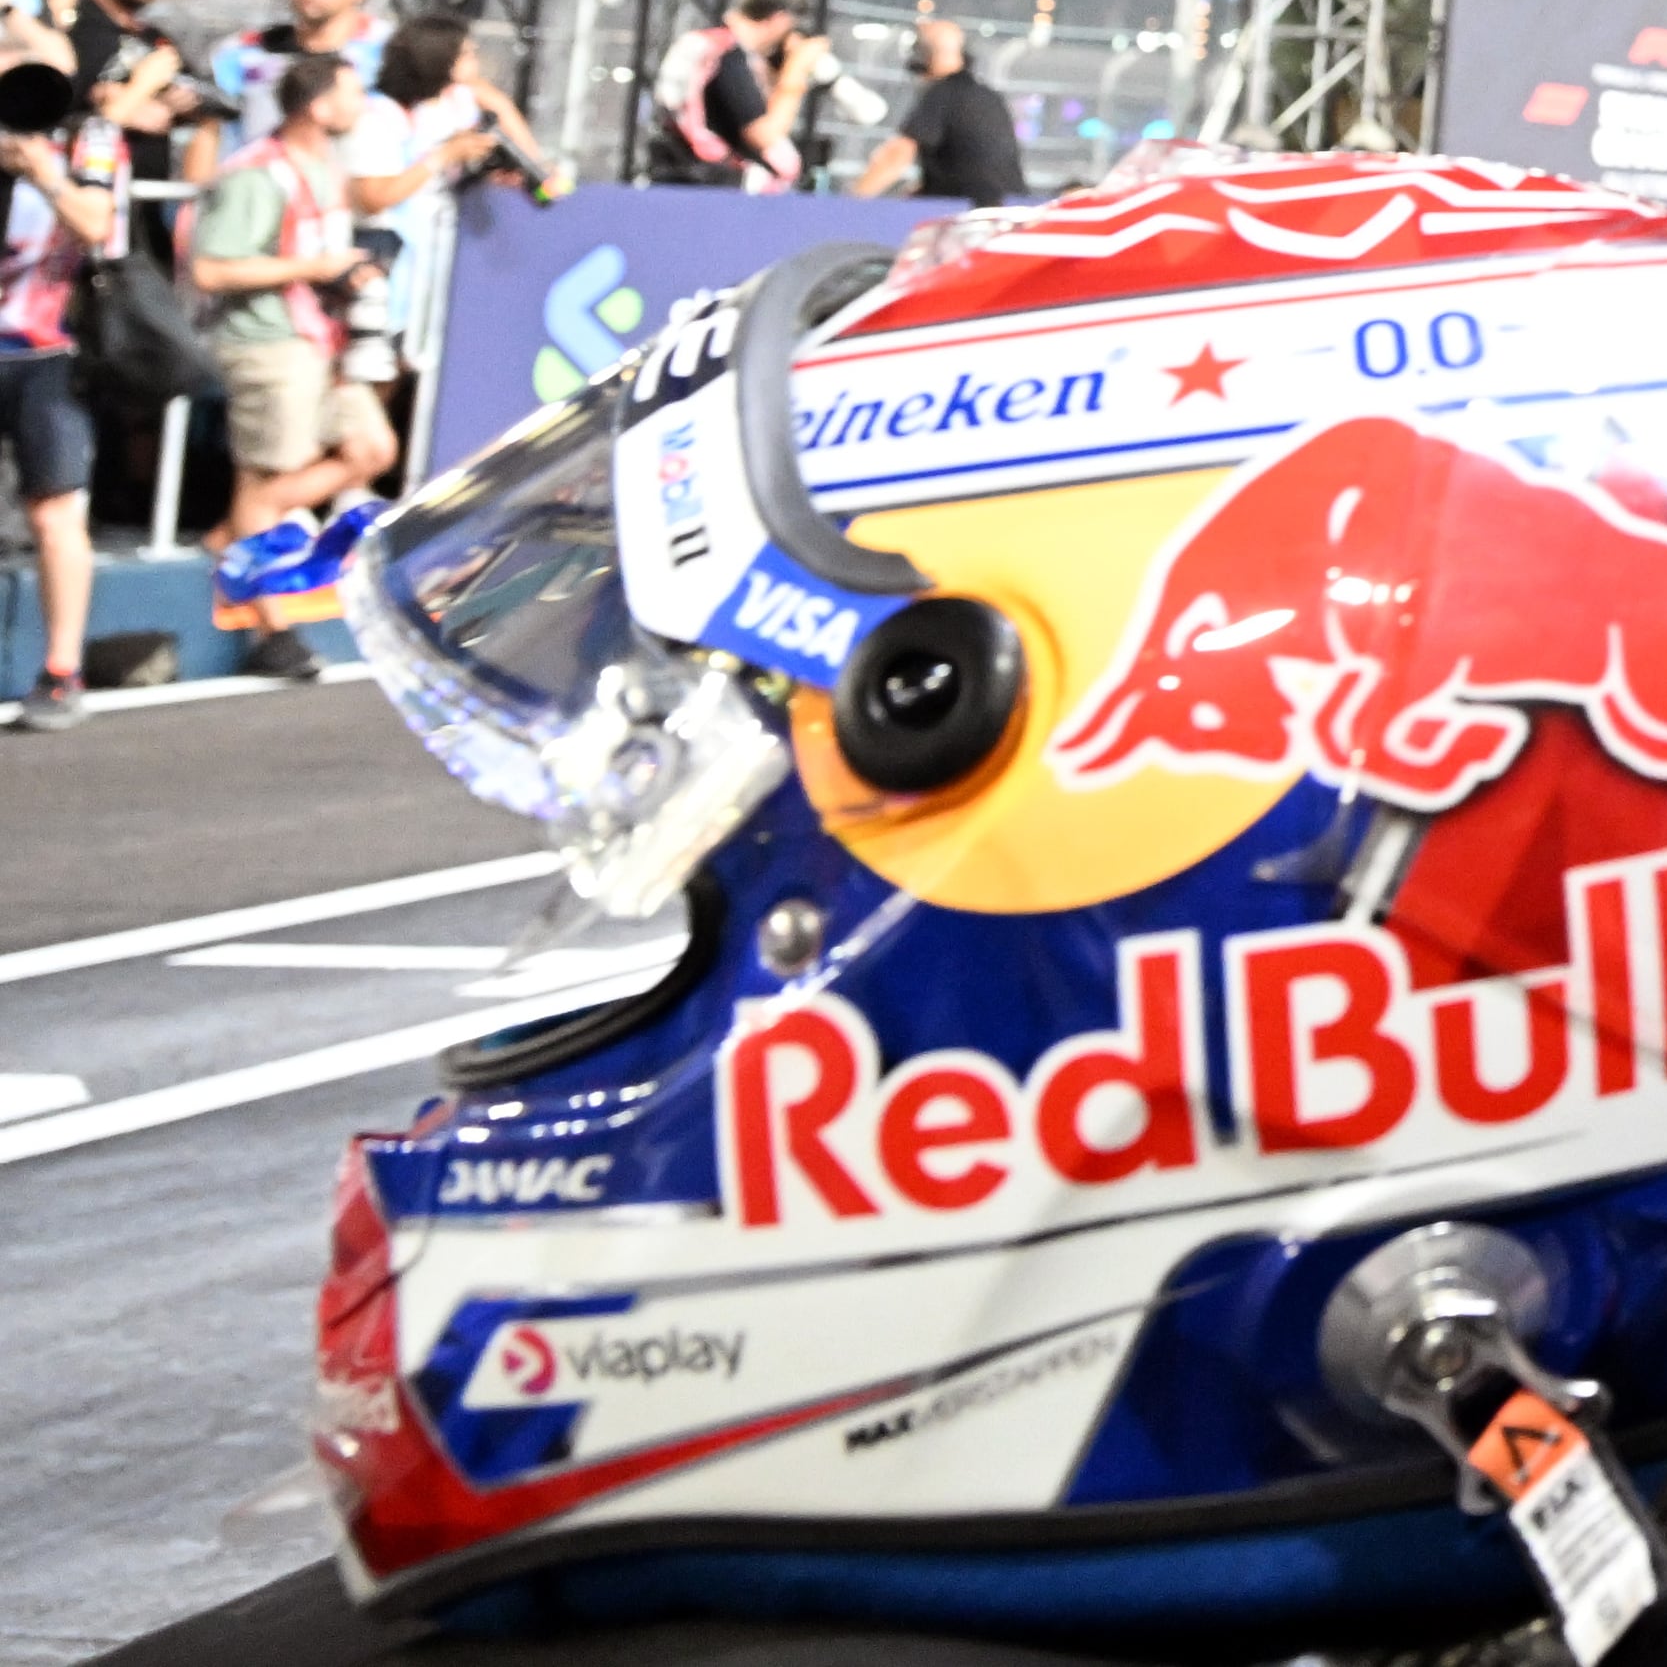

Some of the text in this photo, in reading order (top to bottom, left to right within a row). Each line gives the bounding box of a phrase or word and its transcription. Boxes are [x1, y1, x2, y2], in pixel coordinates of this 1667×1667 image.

[788, 310, 1486, 452] eineken 0.0
[733, 570, 861, 668] VISA
[730, 951, 1200, 1227] Red
[565, 1328, 746, 1383] viaplay
